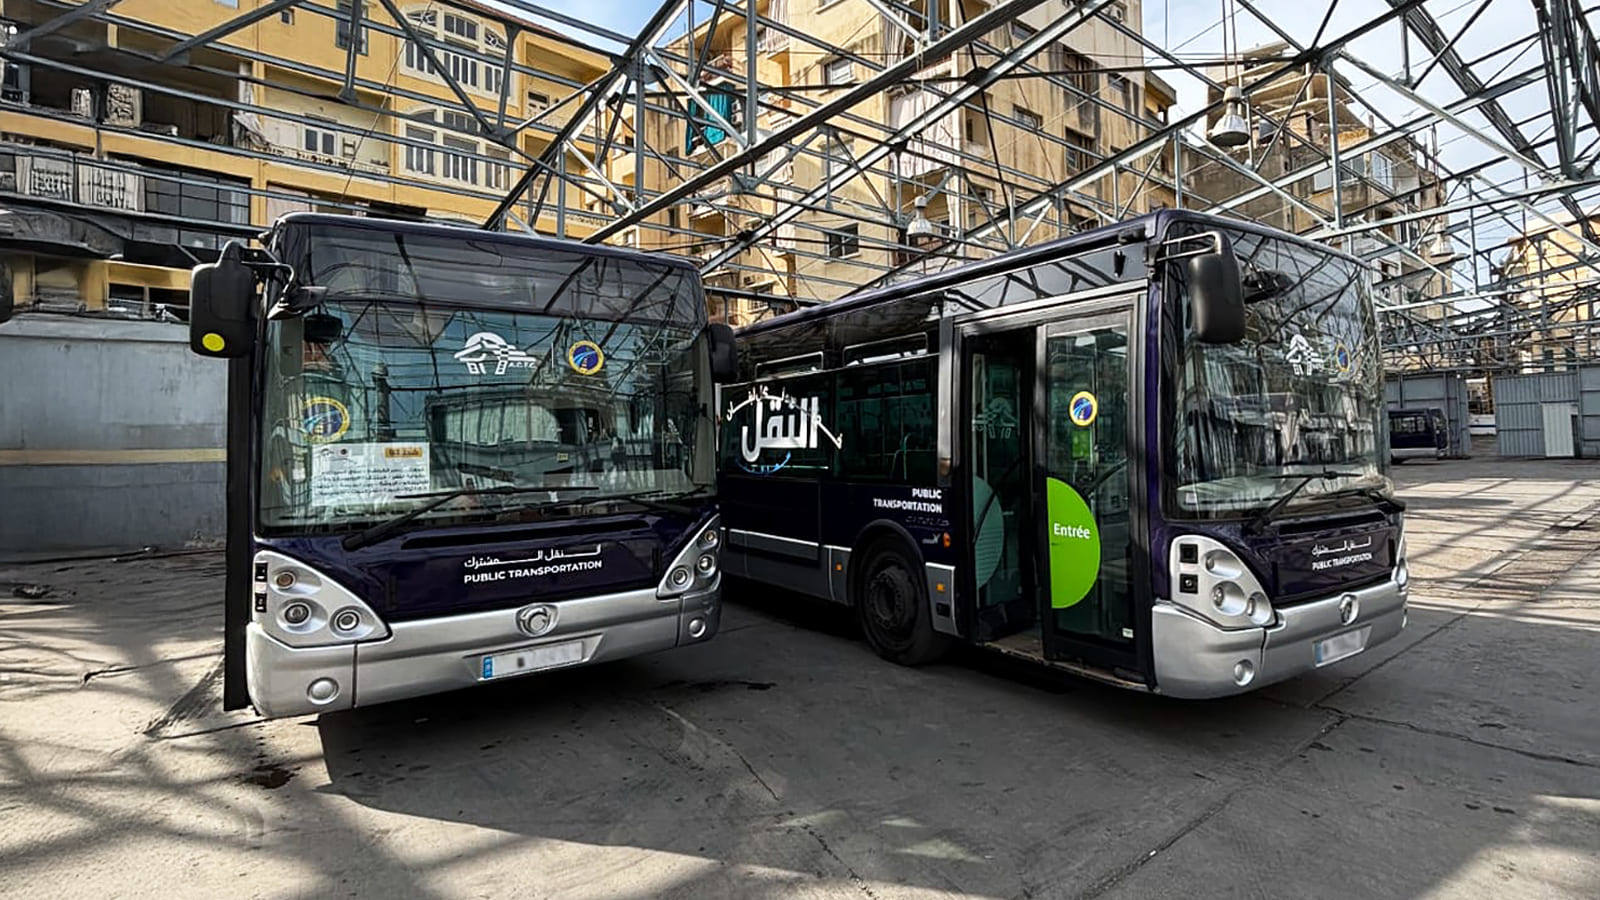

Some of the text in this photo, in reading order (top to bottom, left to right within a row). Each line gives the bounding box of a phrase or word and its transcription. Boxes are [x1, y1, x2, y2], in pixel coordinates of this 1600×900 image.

[741, 395, 819, 463] النقل
[912, 488, 943, 500] PUBLIC
[873, 498, 943, 514] TRANSPORTATION
[1054, 523, 1090, 539] Entrée
[464, 560, 602, 584] PUBLIC TRANSPORTATION
